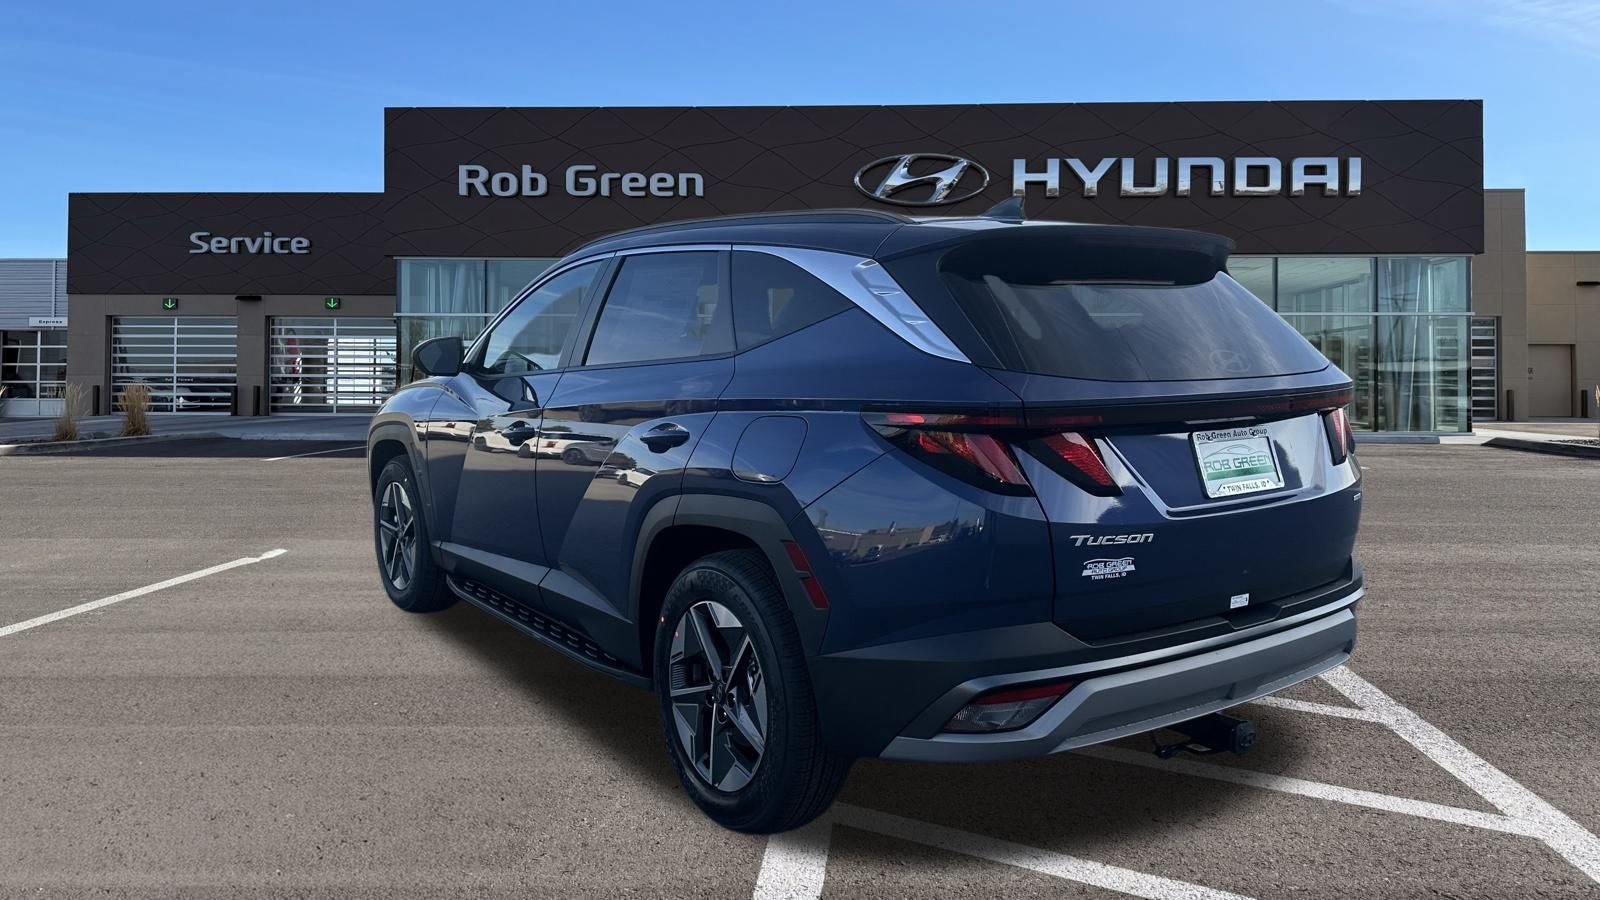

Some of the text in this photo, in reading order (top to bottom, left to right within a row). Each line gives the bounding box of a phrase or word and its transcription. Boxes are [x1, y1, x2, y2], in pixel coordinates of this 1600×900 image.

[458, 164, 704, 197] Rob Green
[1012, 157, 1362, 197] HYUNDAI
[189, 231, 310, 254] Service
[1210, 432, 1232, 440] Green
[1233, 430, 1247, 438] Auto
[1248, 428, 1268, 437] Group
[1203, 454, 1270, 473] ROB GREEN
[1227, 484, 1242, 493] TWIN
[1261, 480, 1267, 488] ID
[1106, 560, 1133, 568] GREEN
